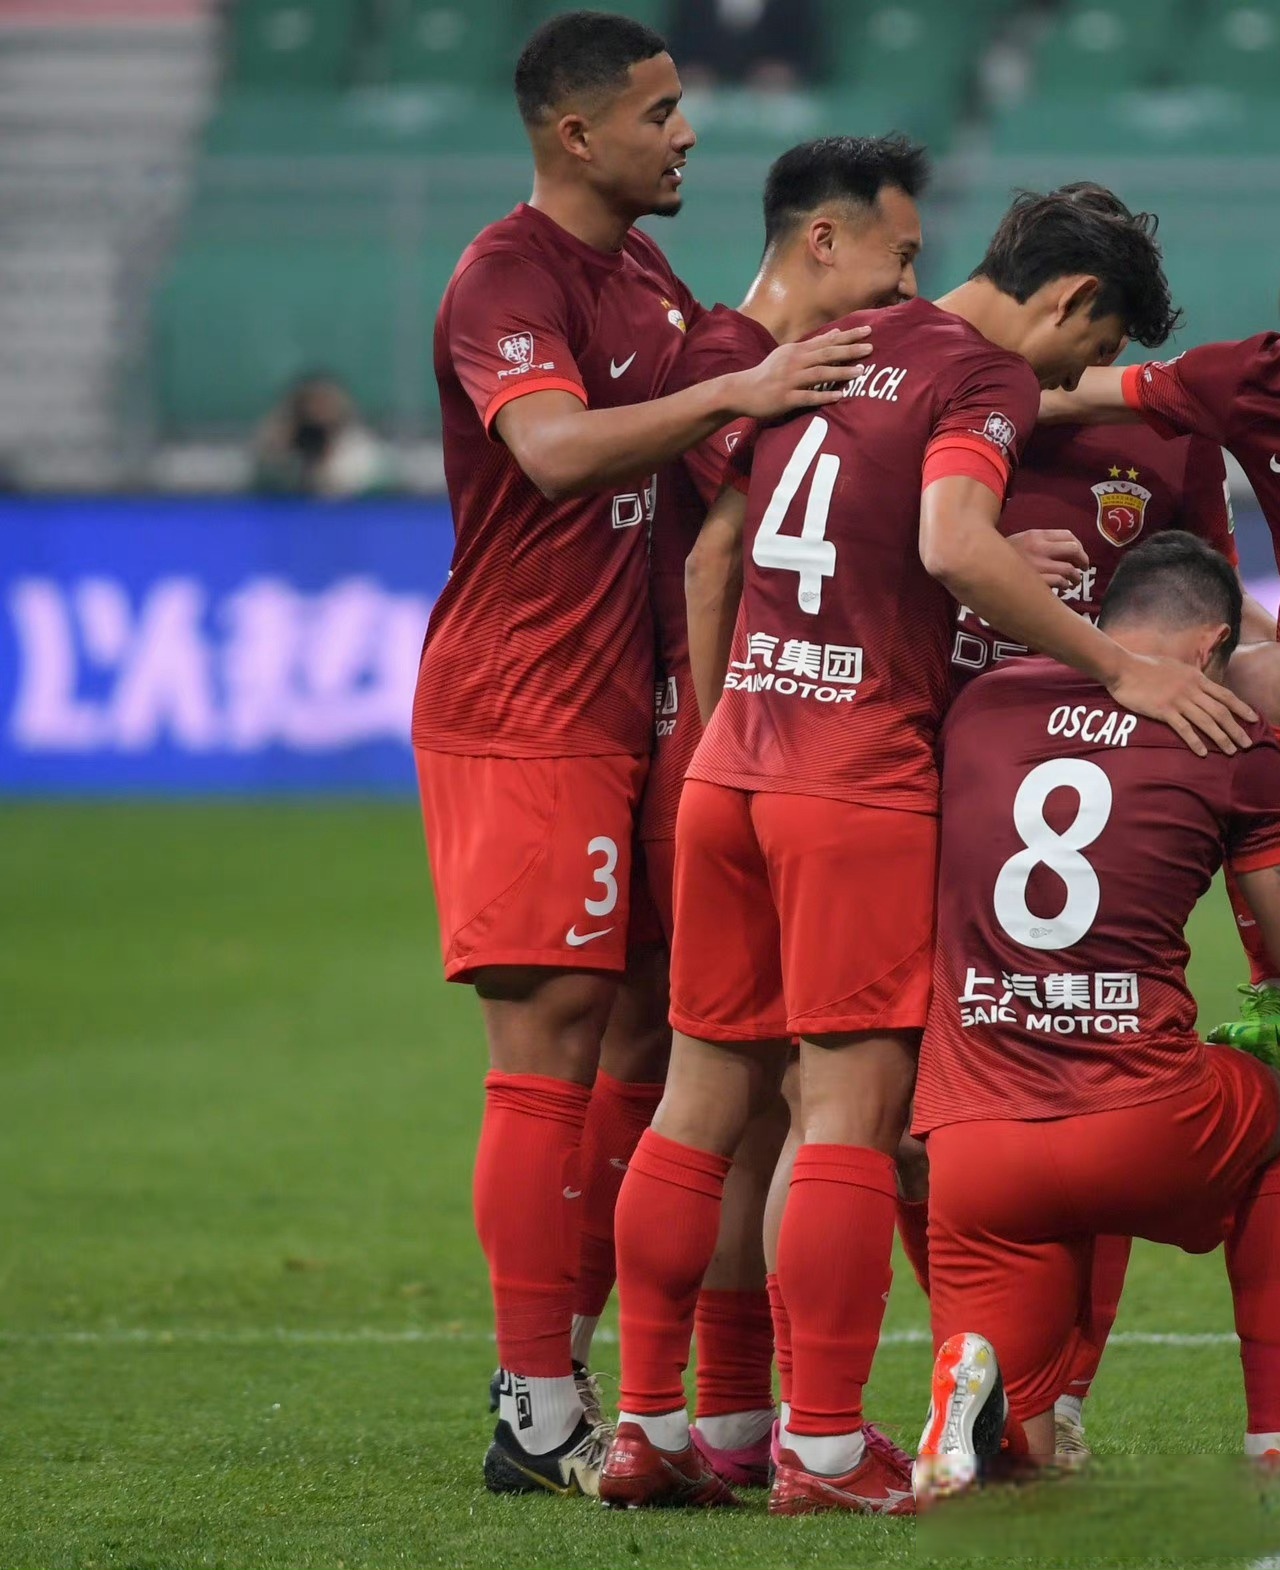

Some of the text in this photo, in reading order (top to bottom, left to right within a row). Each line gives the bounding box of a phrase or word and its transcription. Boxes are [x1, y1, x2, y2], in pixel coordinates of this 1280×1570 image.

[752, 415, 840, 615] 4
[1047, 705, 1137, 747] OSCAR
[584, 835, 618, 917] 3
[993, 757, 1113, 950] 8
[958, 967, 1139, 1010] 上汽集团
[960, 1005, 1140, 1034] SAIC MOTOR
